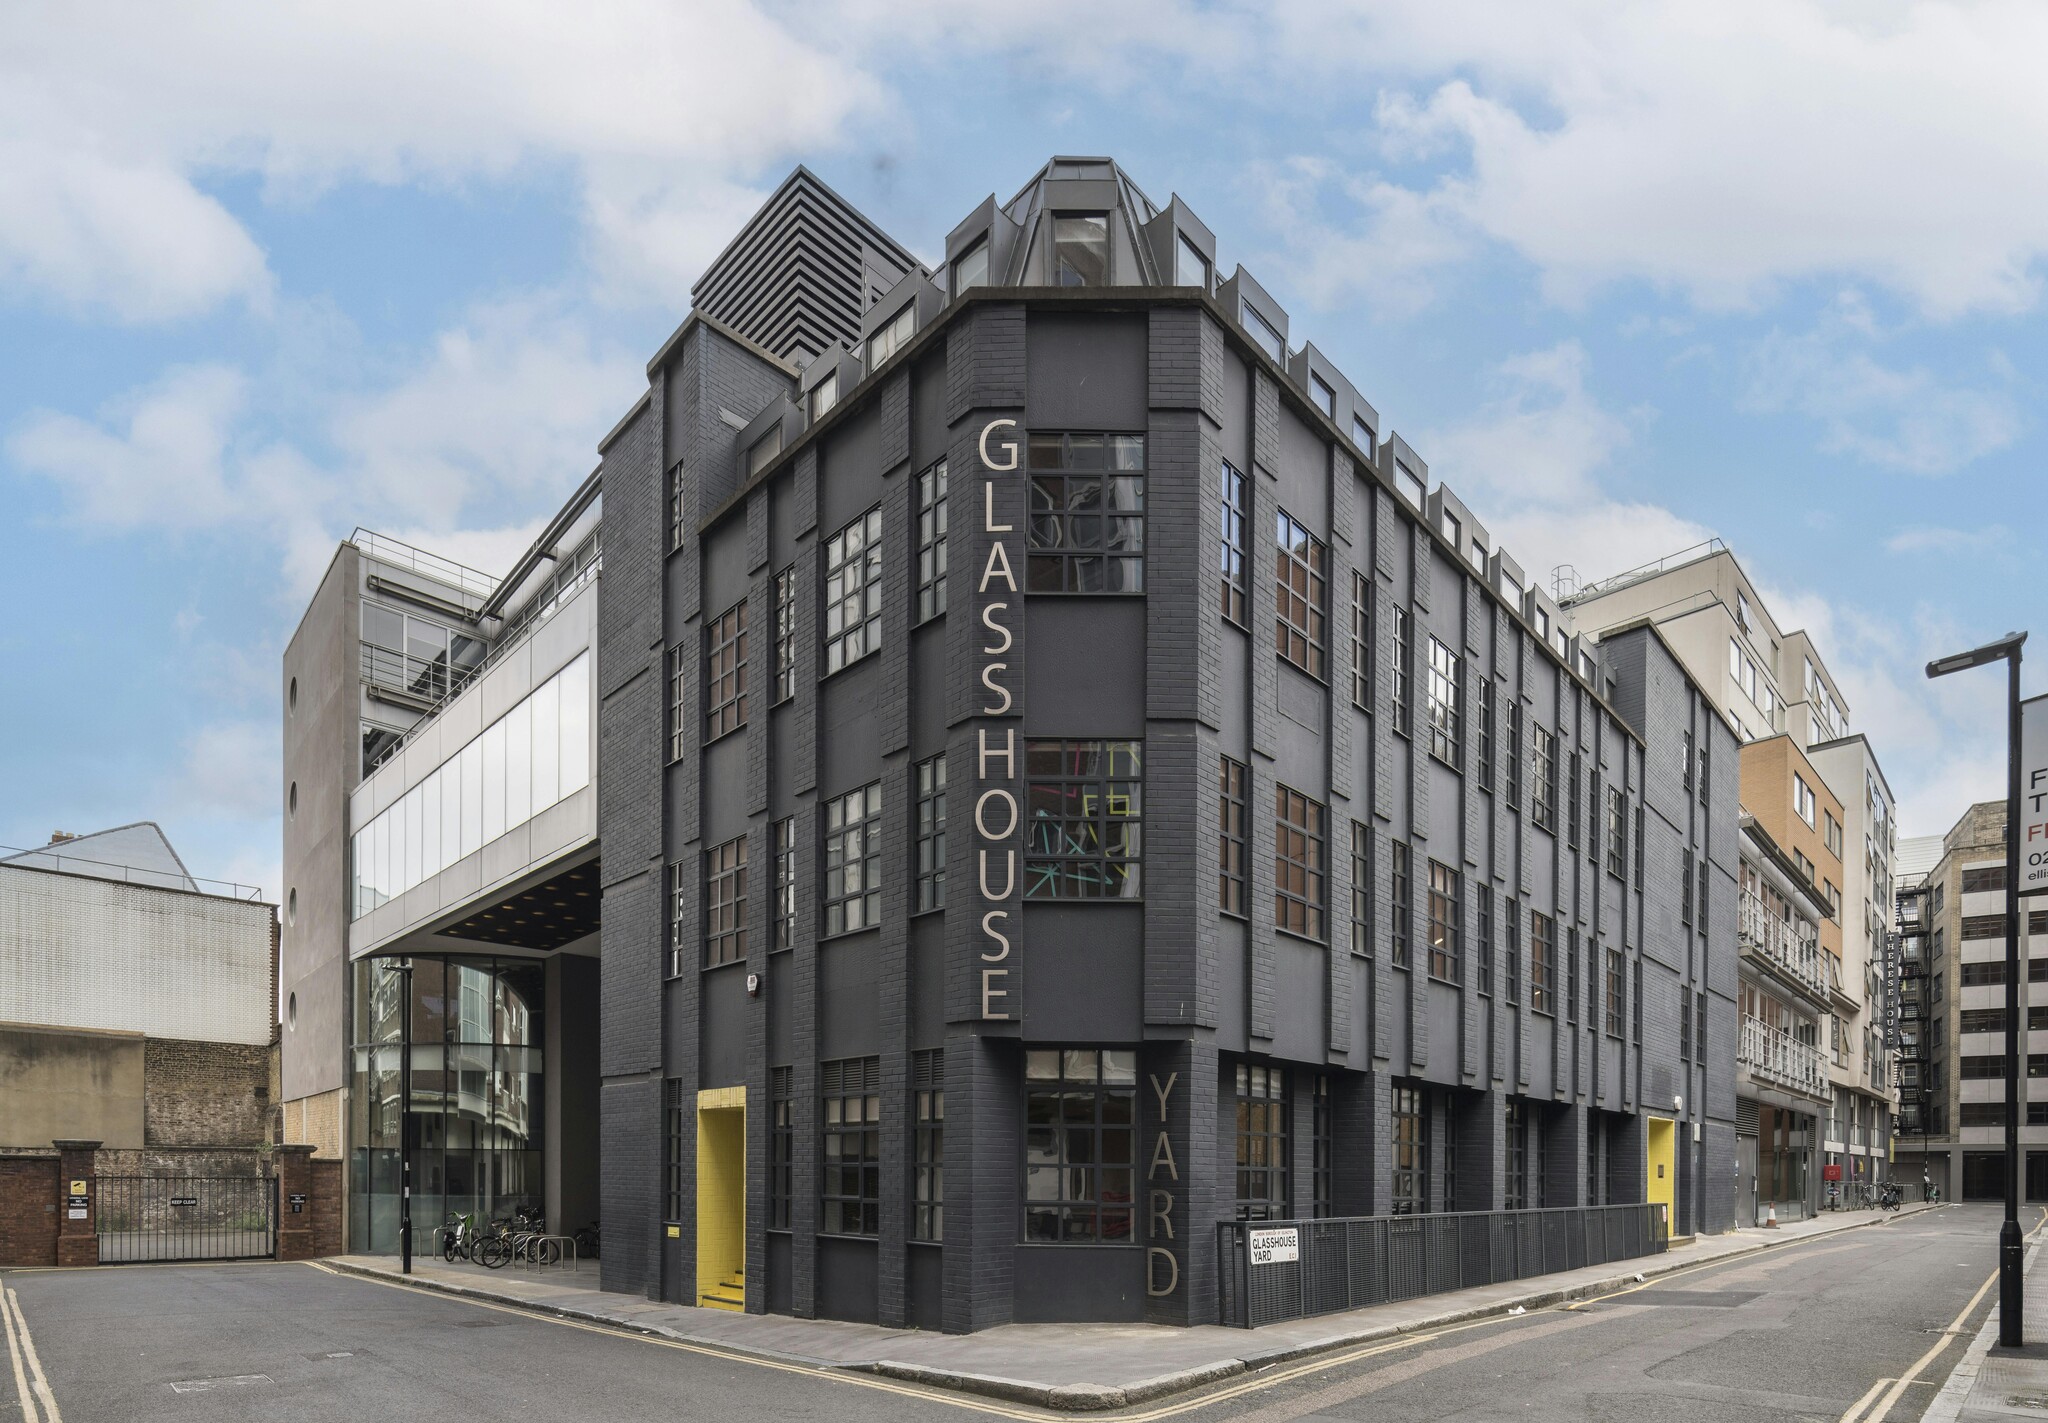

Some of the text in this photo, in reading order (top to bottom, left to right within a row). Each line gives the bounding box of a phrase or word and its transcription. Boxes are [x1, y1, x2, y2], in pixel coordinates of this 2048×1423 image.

[975, 419, 1018, 1020] GLASSHOUSE
[1886, 934, 1895, 1044] THERESE HOUSE
[1148, 1072, 1179, 1297] YARD
[1252, 1236, 1296, 1249] GLASSHOUSE
[1253, 1250, 1272, 1262] YARD
